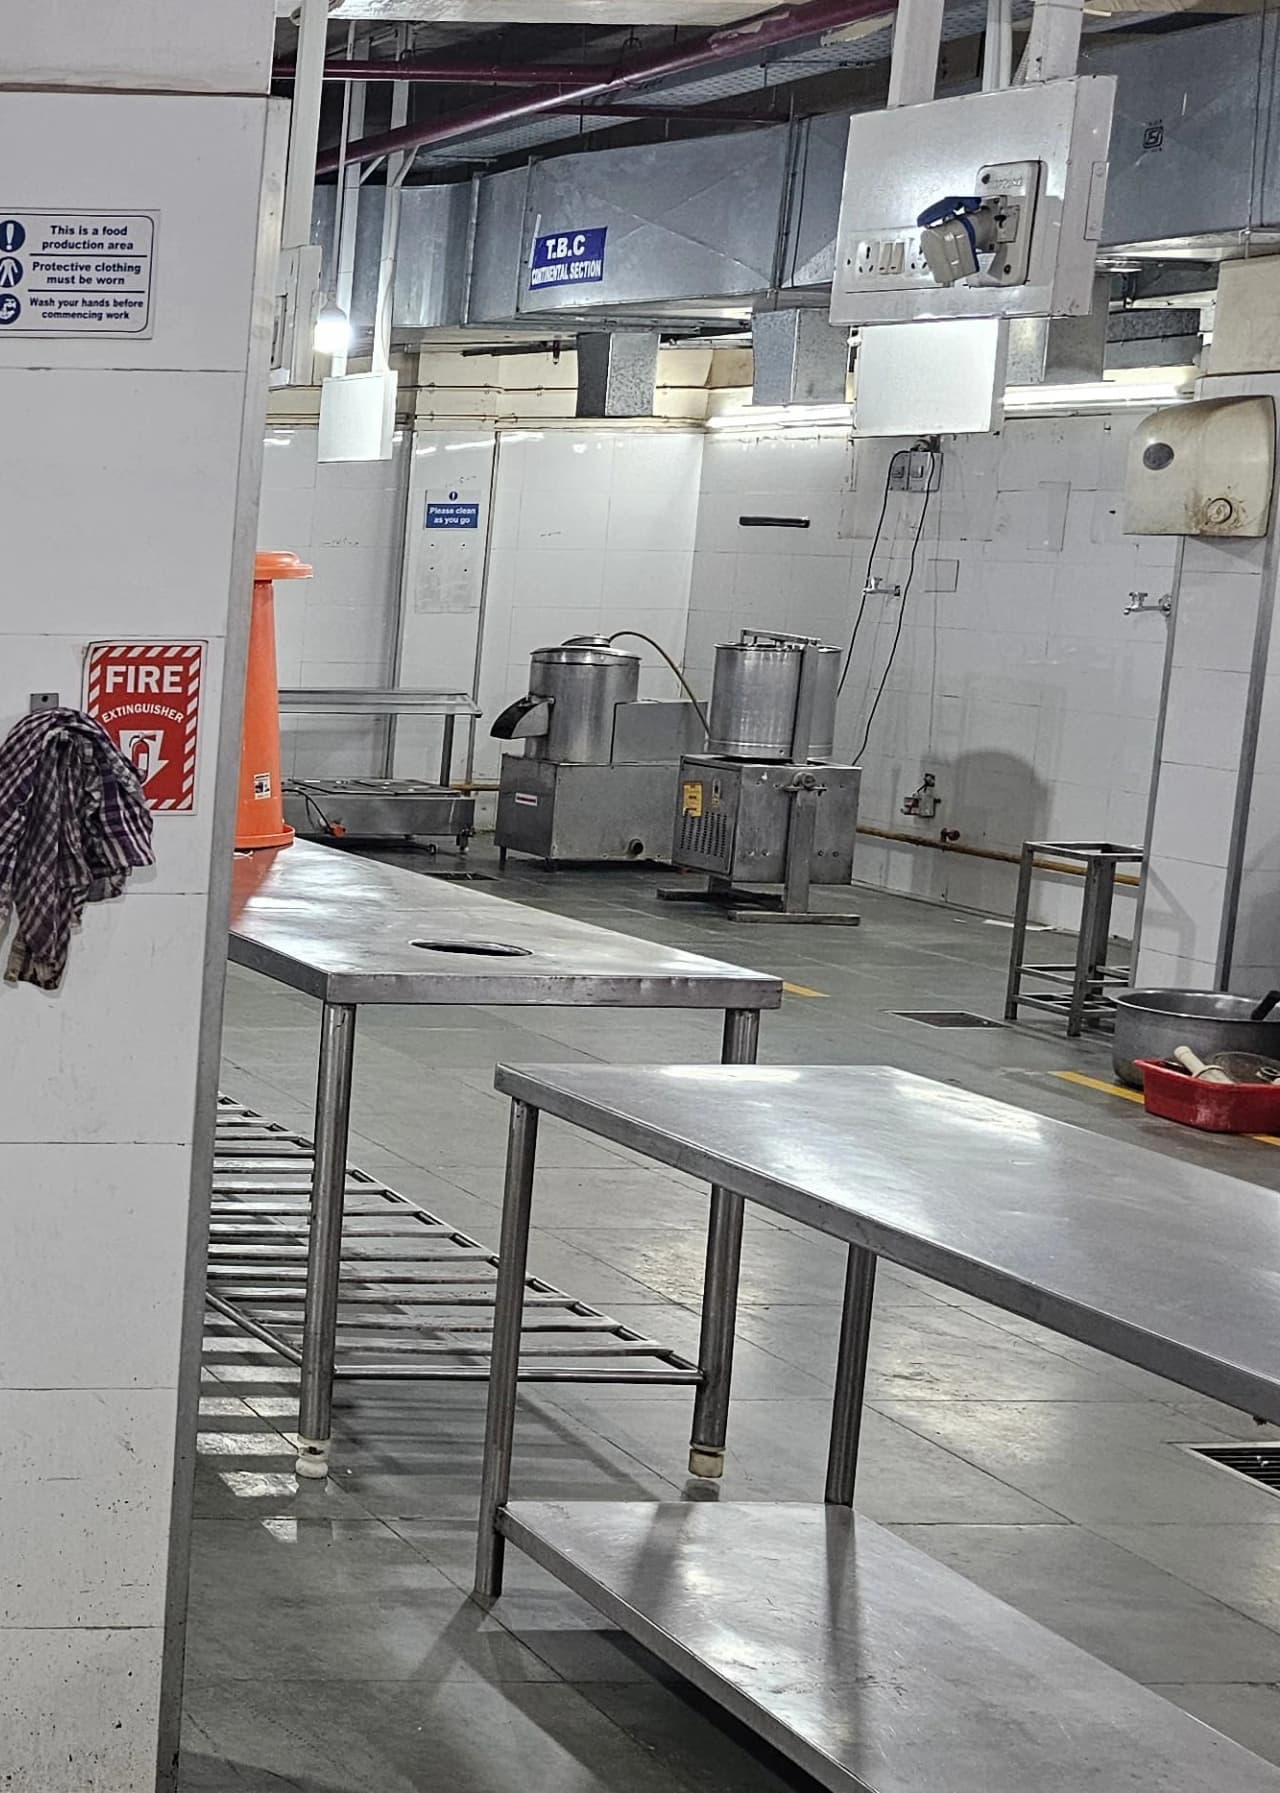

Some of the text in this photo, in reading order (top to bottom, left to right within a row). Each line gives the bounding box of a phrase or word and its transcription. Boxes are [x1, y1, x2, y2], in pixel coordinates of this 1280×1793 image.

[50, 225, 128, 236] This is a food
[42, 240, 134, 250] production area
[546, 234, 586, 260] T.B.C
[32, 262, 141, 274] Protective clothing
[531, 259, 602, 286] CONTINENTAL SECTION
[46, 274, 125, 285] must be worn
[30, 298, 144, 309] Wash your hands before
[42, 310, 130, 321] commencing work
[429, 506, 476, 514] Please clean
[444, 517, 459, 525] you
[460, 517, 470, 525] go
[105, 665, 184, 694] FIRE
[101, 703, 184, 724] EXTINGUISHER
